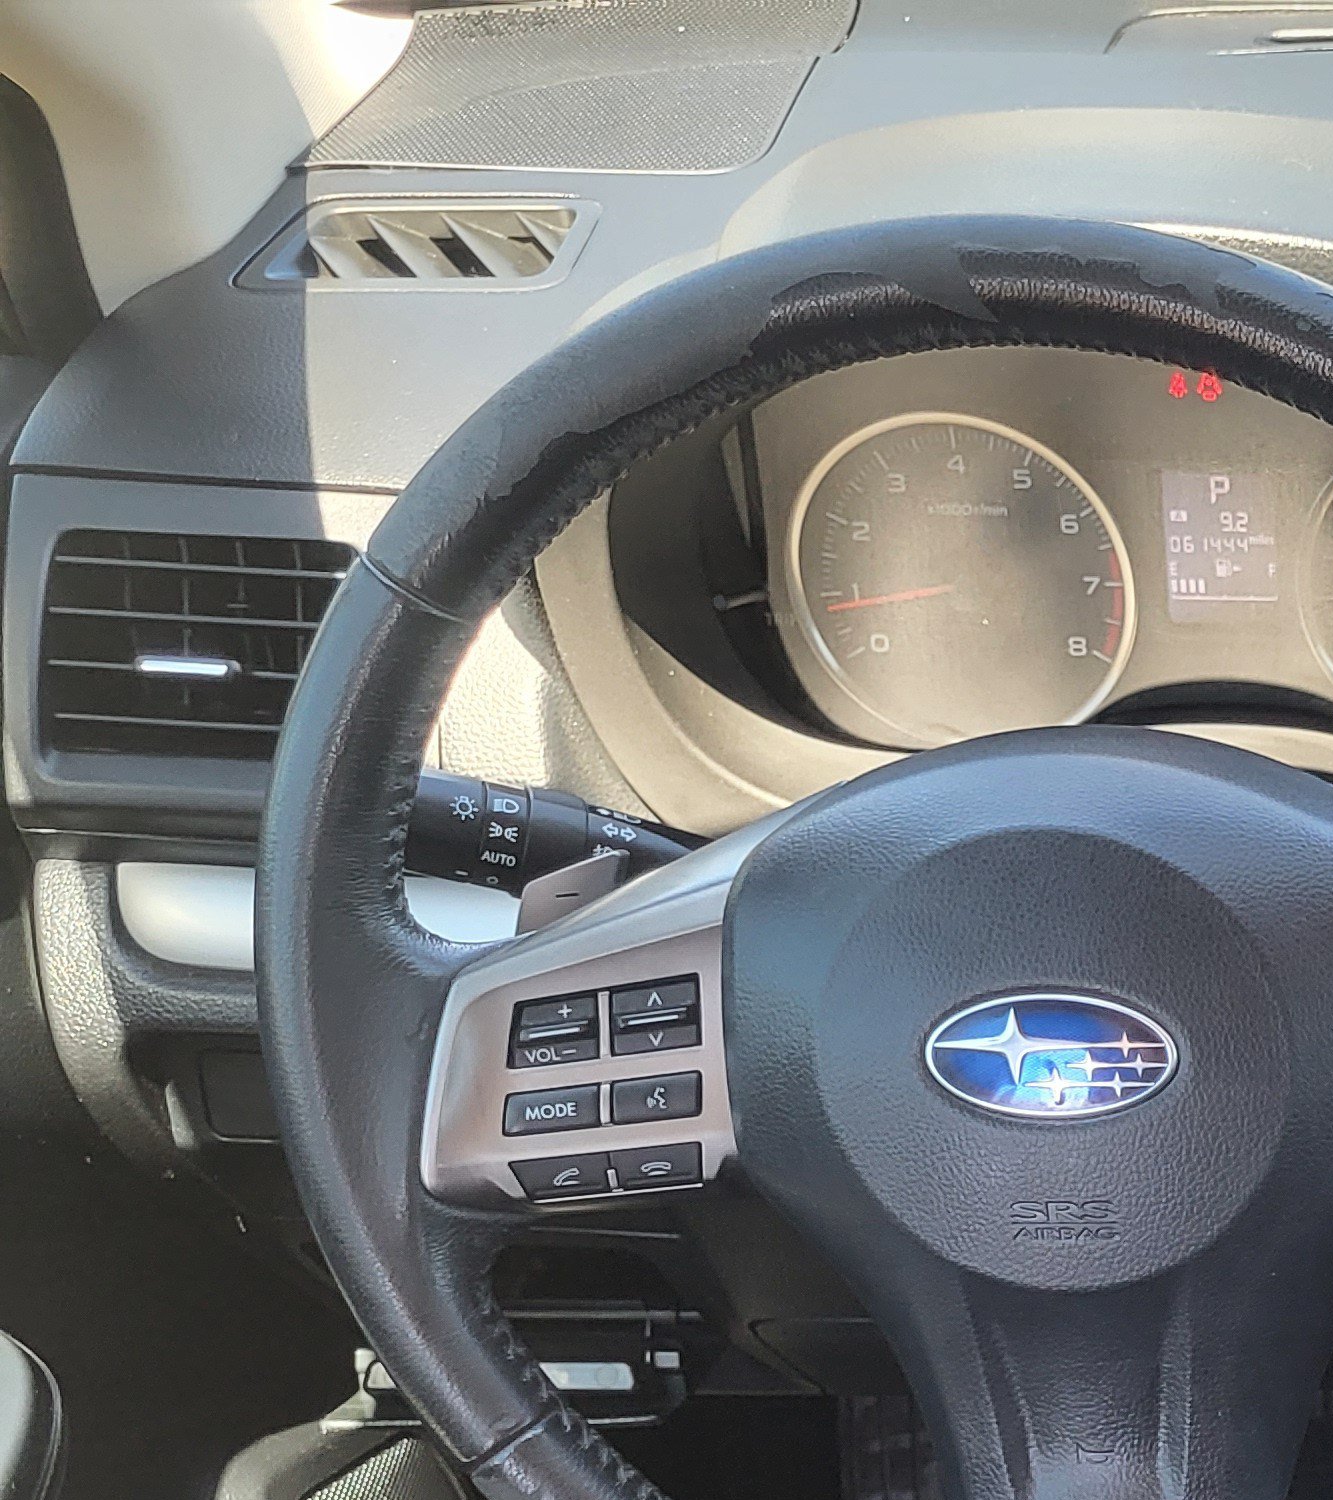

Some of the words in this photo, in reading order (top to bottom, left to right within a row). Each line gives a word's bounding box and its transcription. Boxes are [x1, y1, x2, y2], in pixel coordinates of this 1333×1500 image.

[947, 455, 966, 474] 4
[887, 473, 907, 494] 3
[1012, 469, 1033, 490] 5
[1210, 476, 1230, 504] P
[852, 521, 871, 541] 2
[1060, 515, 1080, 535] 6
[1082, 576, 1100, 595] 7
[870, 634, 890, 652] 0
[1067, 636, 1088, 656] 8
[481, 849, 516, 867] AUTO
[525, 1101, 578, 1122] MODE
[1010, 1200, 1117, 1221] SRS
[1012, 1225, 1121, 1241] AIRBAG
